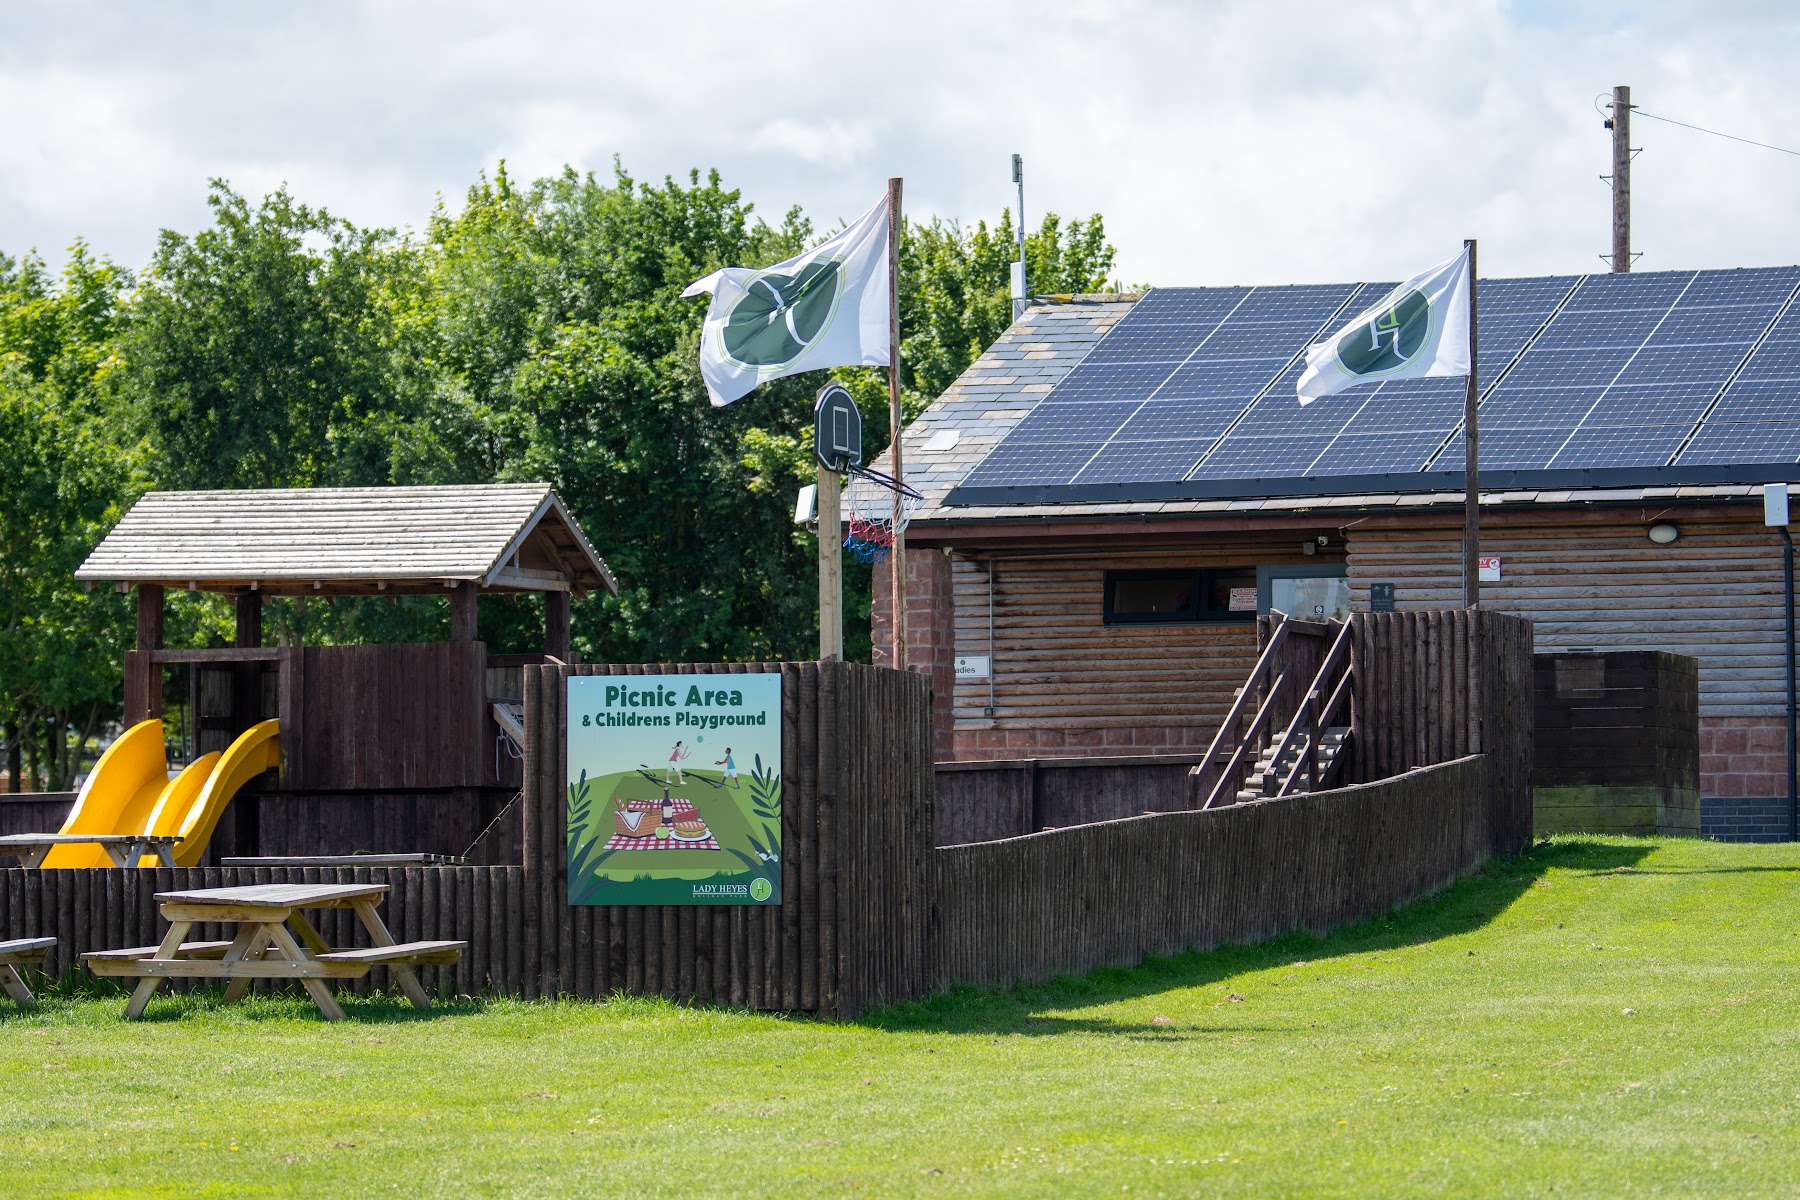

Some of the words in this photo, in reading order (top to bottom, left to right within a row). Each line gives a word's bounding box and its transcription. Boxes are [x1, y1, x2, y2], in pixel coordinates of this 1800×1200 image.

[605, 684, 677, 707] Picnic
[684, 685, 743, 706] Area
[582, 714, 591, 727] &
[595, 712, 671, 727] Childrens
[675, 711, 766, 729] Playground
